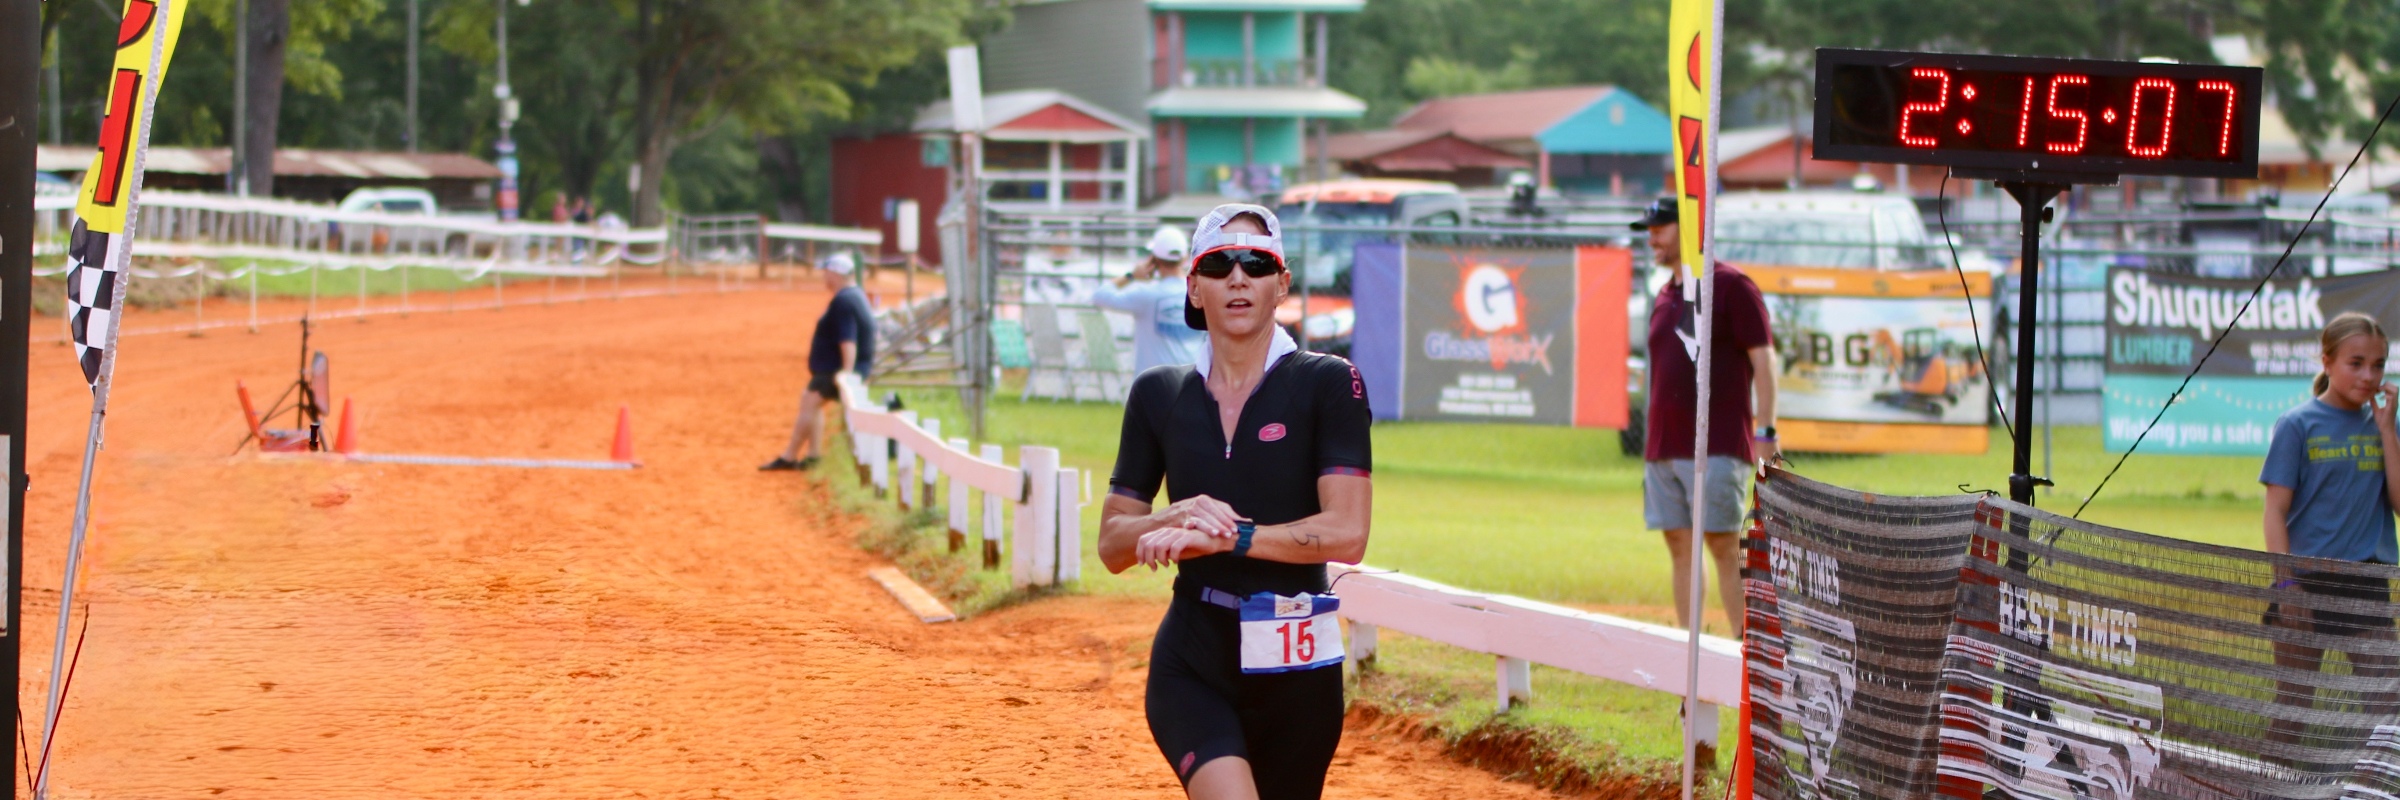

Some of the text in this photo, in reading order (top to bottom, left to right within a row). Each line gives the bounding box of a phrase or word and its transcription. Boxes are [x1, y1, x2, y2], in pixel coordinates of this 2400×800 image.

[1464, 264, 1518, 332] G
[2112, 334, 2194, 366] LUMBER
[2179, 423, 2209, 448] you
[2212, 425, 2222, 443] a
[2226, 421, 2263, 444] safe
[1769, 537, 1840, 607] BEST TIMES
[1276, 619, 1316, 665] 15
[1999, 580, 2138, 667] BEST TIMES
